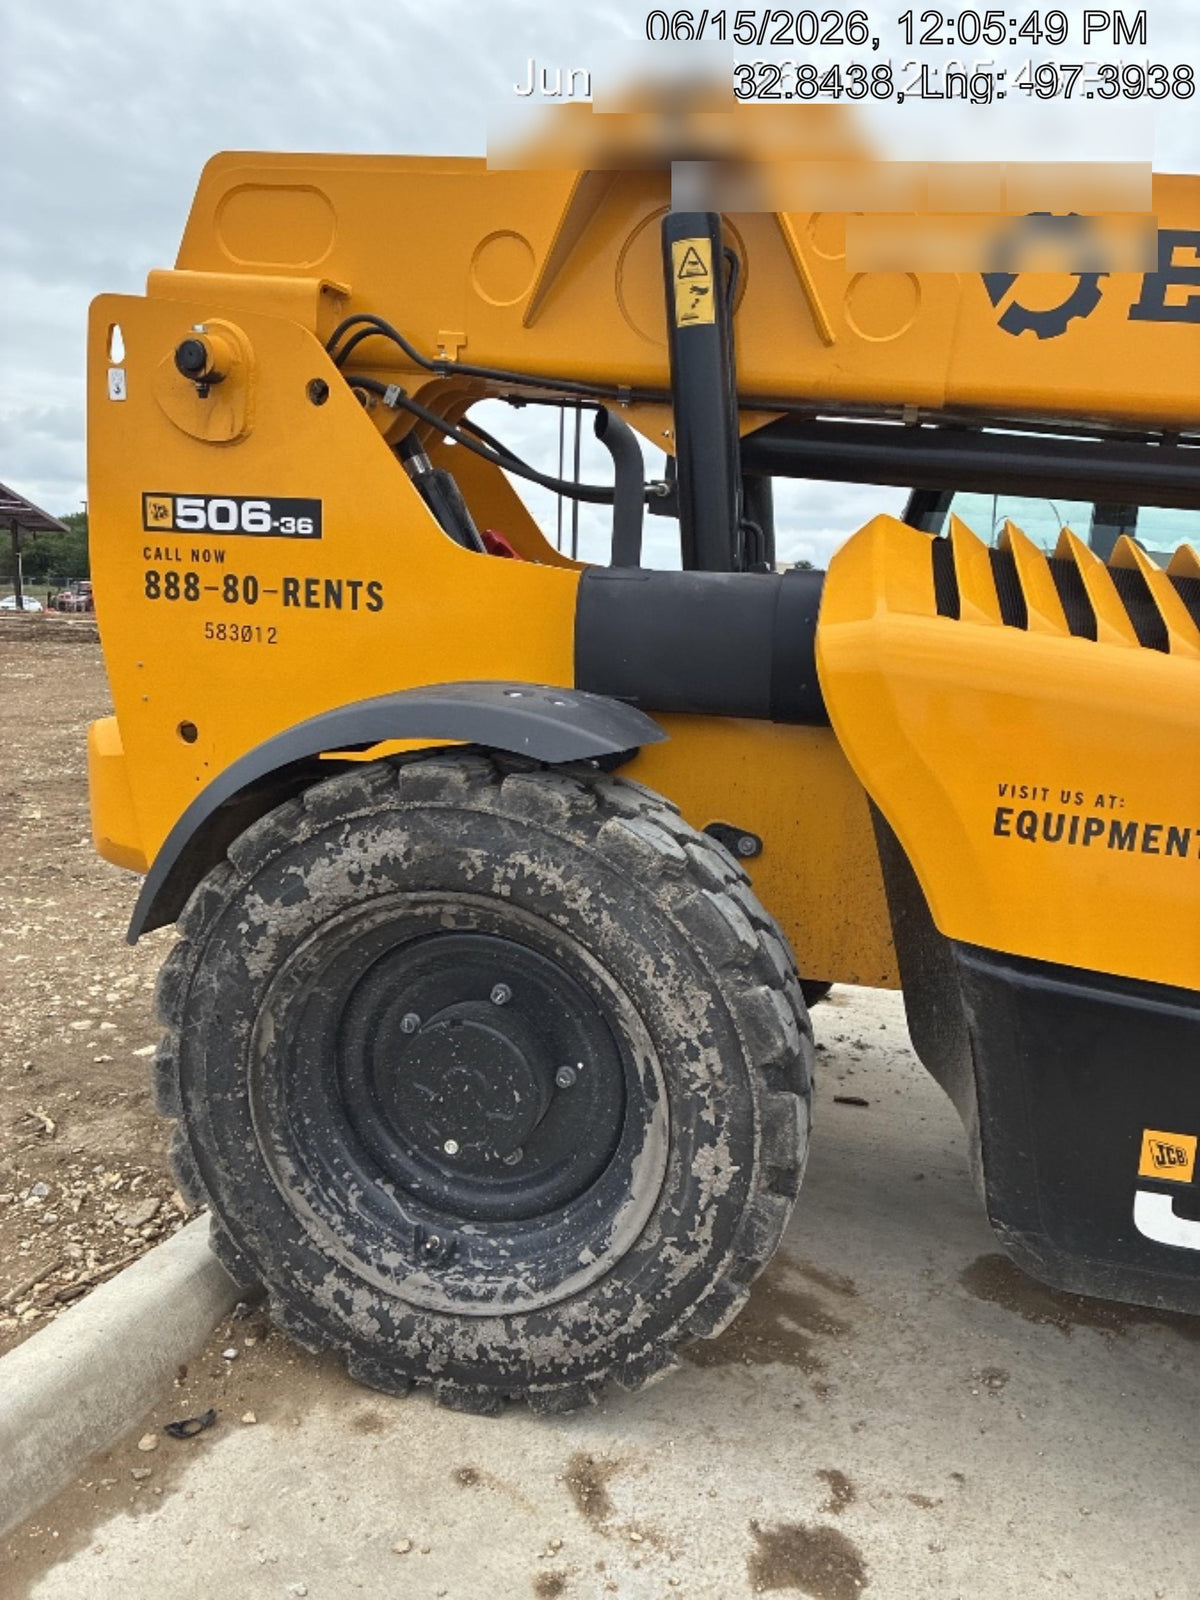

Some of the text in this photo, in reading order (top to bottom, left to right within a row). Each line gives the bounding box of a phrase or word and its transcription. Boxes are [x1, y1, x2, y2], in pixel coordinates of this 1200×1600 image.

[175, 498, 313, 534] 506-36
[143, 547, 226, 564] CALL NOW
[145, 570, 384, 612] 888-80-RENTS
[998, 783, 1126, 809] VISIT US AT:
[993, 806, 1200, 860] EQUIPMEN
[1155, 1142, 1187, 1167] JCB
